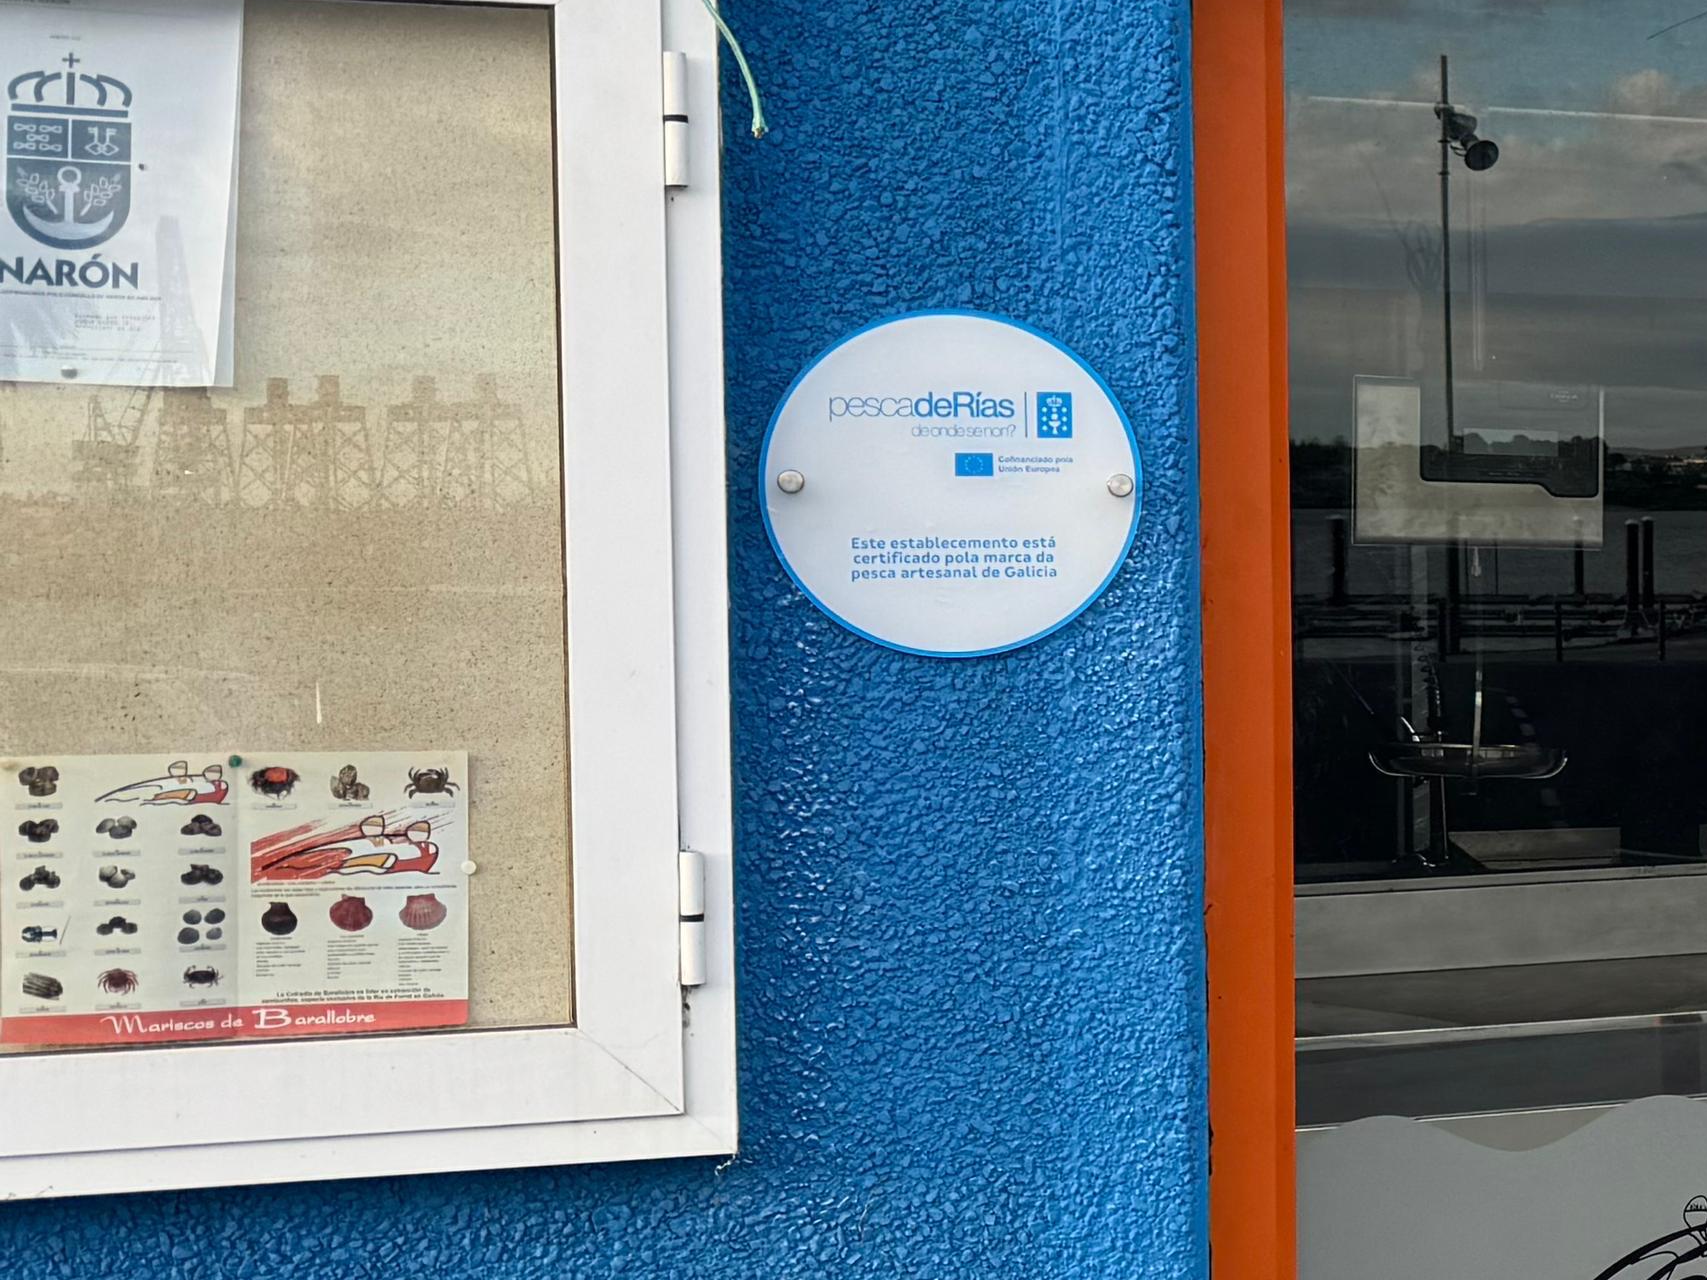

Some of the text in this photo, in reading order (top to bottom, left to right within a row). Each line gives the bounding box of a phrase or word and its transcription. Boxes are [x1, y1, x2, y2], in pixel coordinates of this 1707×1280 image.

[0, 253, 139, 290] NARÓN
[851, 535, 1056, 550] Este establecemento está
[853, 550, 1055, 567] certificado pola marca da
[851, 566, 1058, 582] pesca artesanal de Galicia
[100, 1007, 376, 1034] Mariscos de Barallobre
